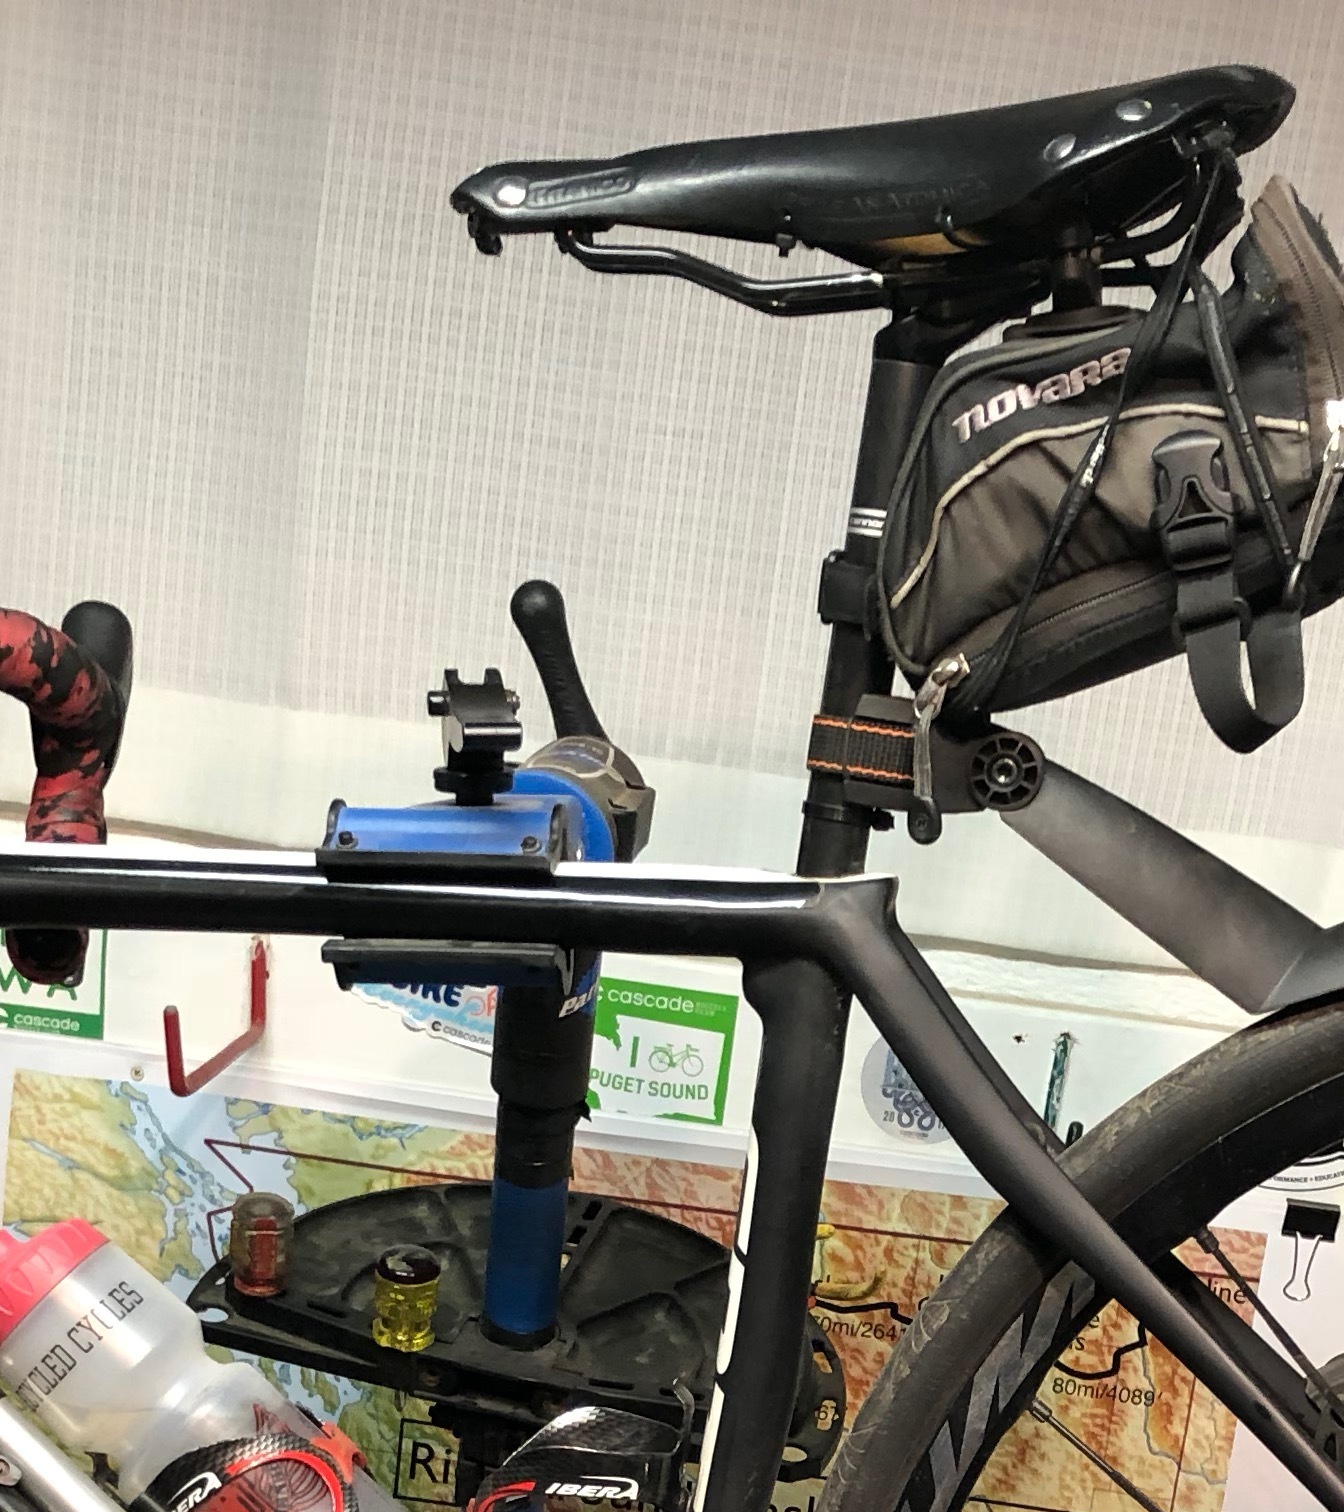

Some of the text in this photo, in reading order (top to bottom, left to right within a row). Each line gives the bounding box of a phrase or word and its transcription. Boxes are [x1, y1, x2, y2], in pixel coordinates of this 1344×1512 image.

[607, 988, 695, 1014] cascade
[13, 1013, 80, 1032] cascade
[629, 1035, 641, 1069] I
[589, 1067, 710, 1101] PUGET SOUND
[67, 1280, 145, 1354] CYCLES
[545, 1475, 640, 1500] IBERA
